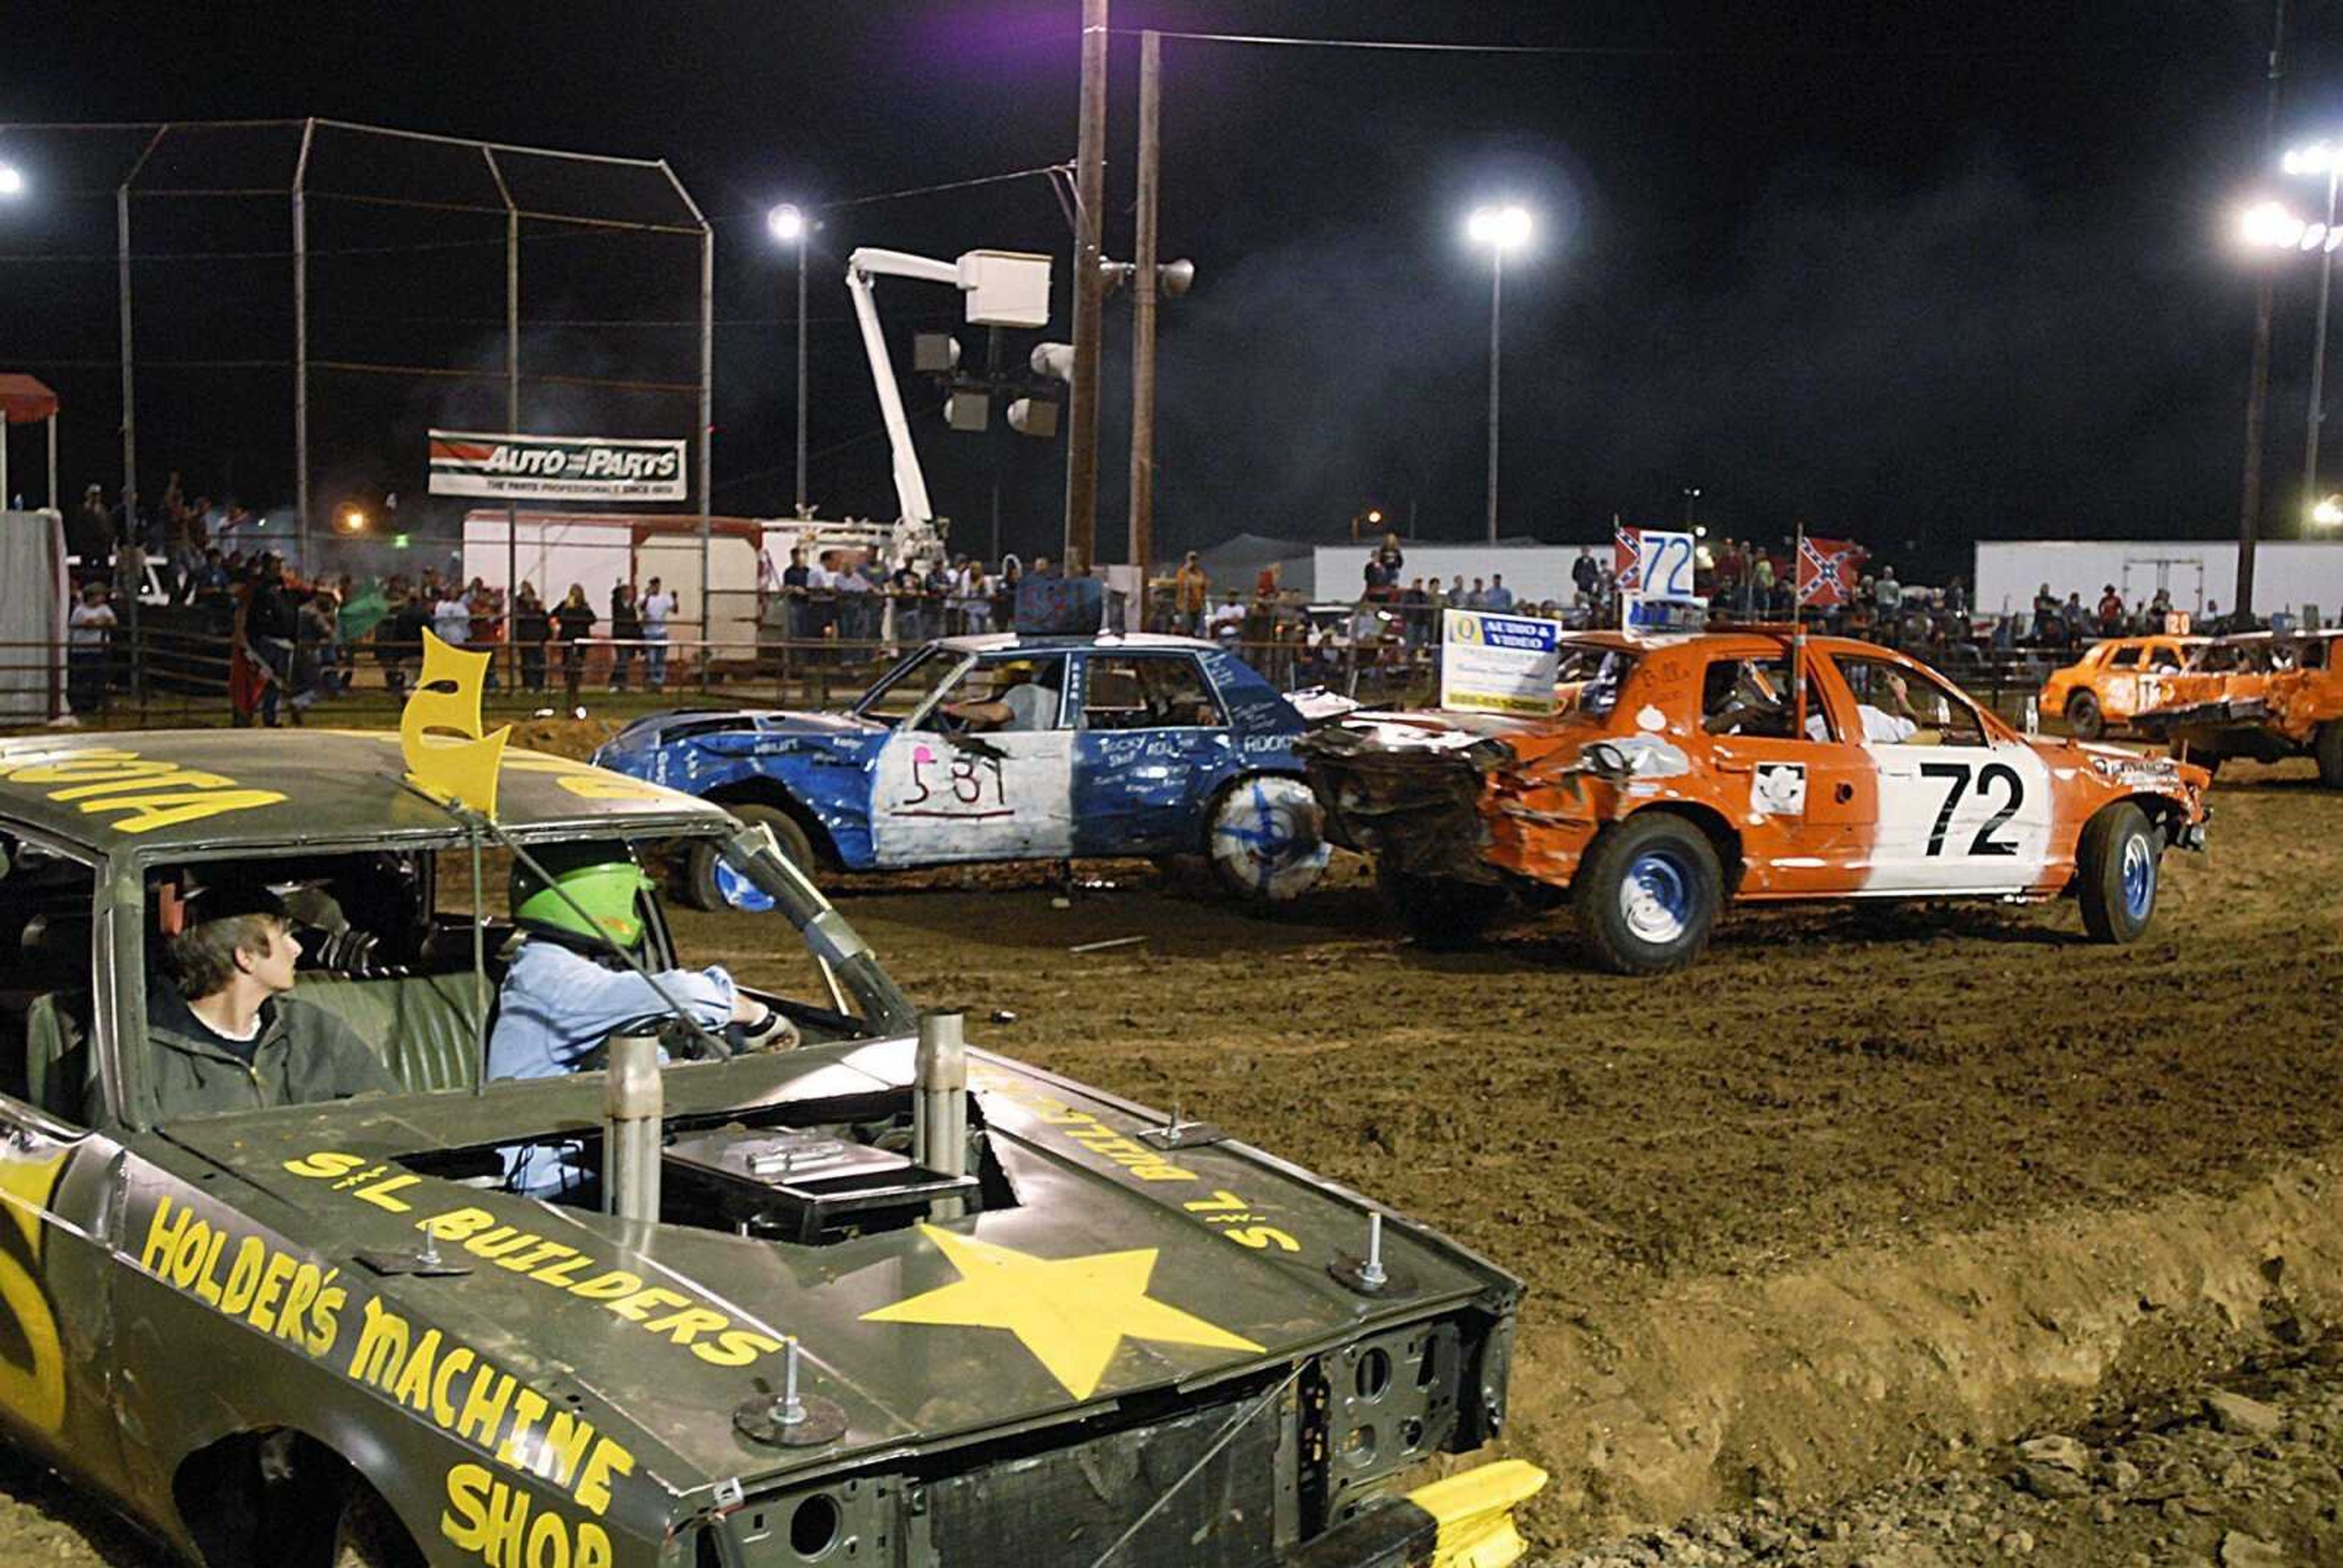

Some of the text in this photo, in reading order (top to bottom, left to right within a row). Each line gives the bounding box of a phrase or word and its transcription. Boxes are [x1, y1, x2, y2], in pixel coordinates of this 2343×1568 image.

[487, 445, 676, 478] AUTO PARTS
[1643, 536, 1691, 595] 72
[1920, 762, 2024, 856] 72
[416, 1206, 785, 1367] BUILDERS
[348, 1295, 635, 1515] MACHINE
